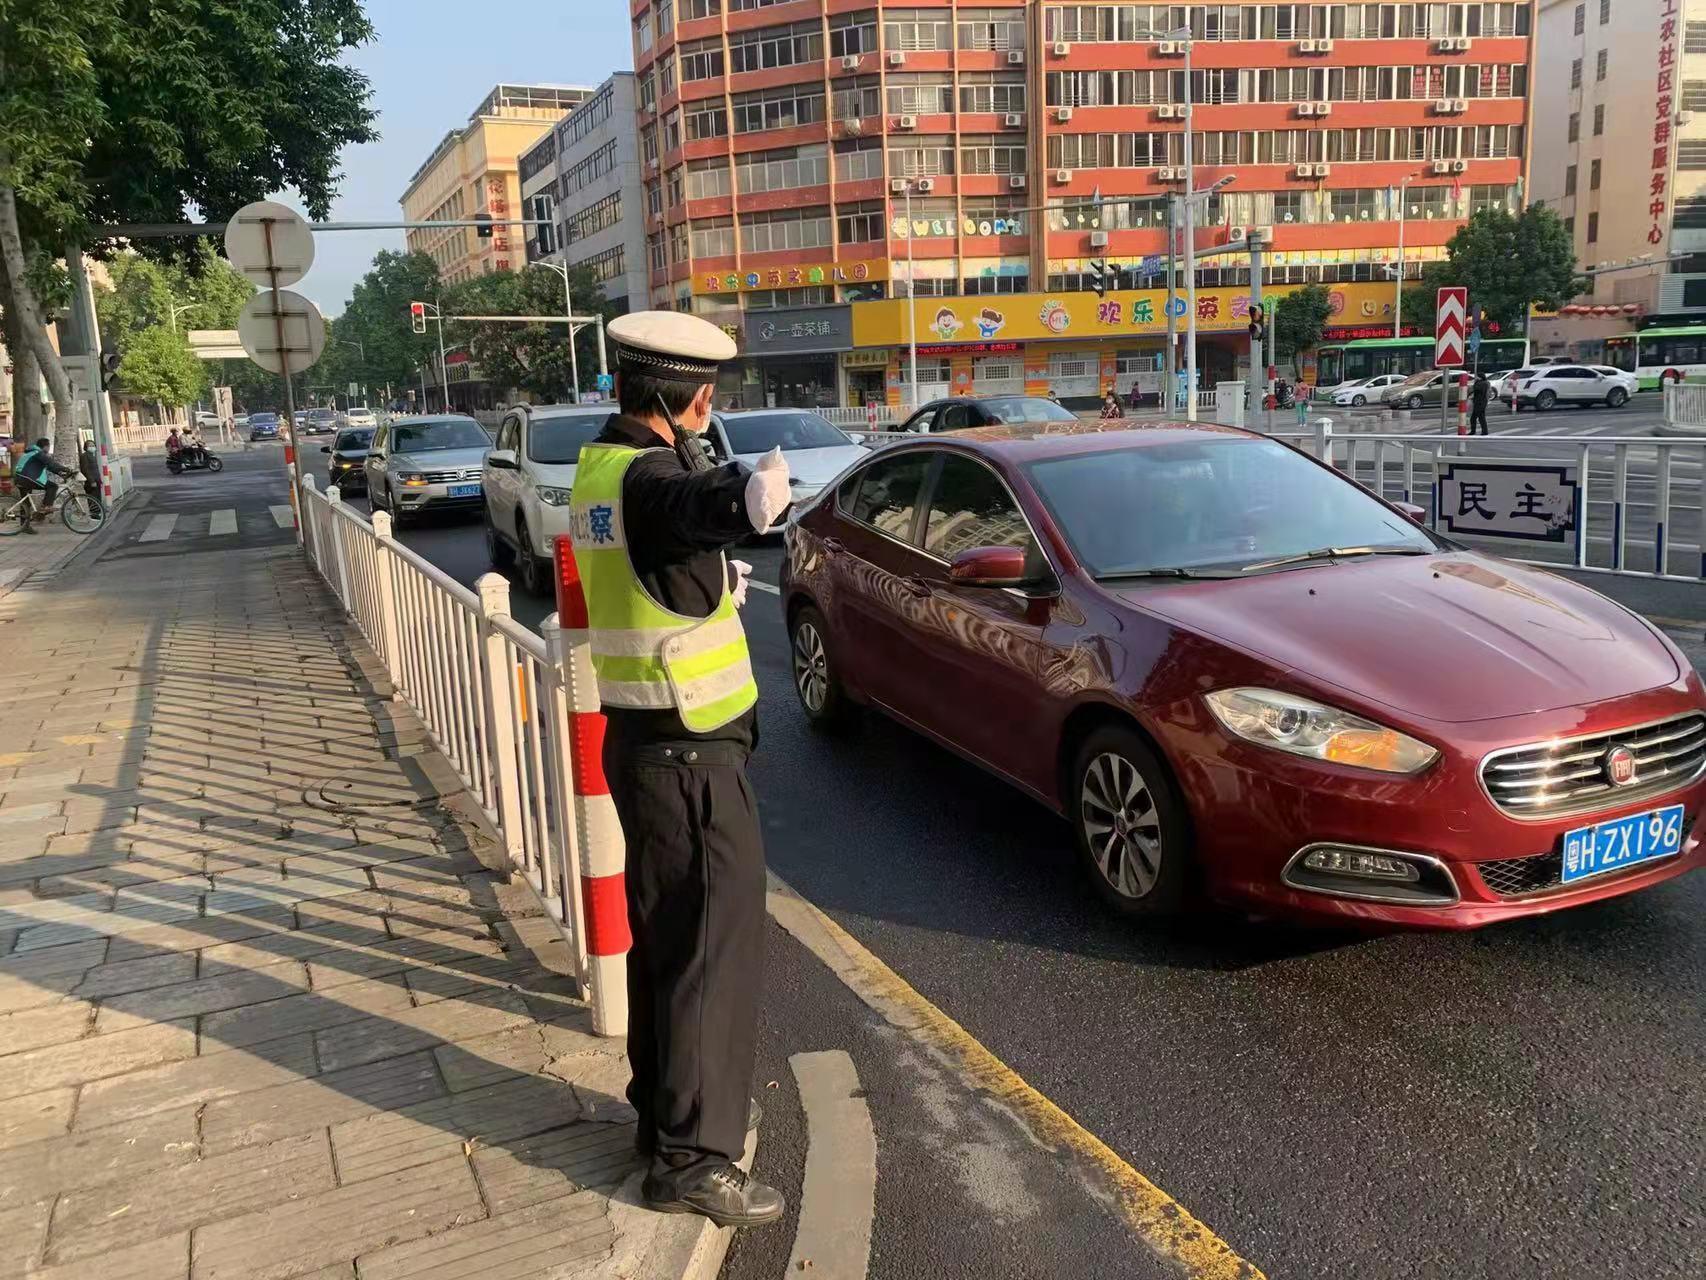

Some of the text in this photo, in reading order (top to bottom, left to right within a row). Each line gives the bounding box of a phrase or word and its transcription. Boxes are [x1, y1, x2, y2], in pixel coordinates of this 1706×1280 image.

[706, 263, 868, 291] 欢乐中英文幼儿园
[1098, 291, 1345, 324] 欢乐中英文幼园
[777, 320, 831, 337] 一壶茶铺
[1458, 481, 1553, 522] 民主
